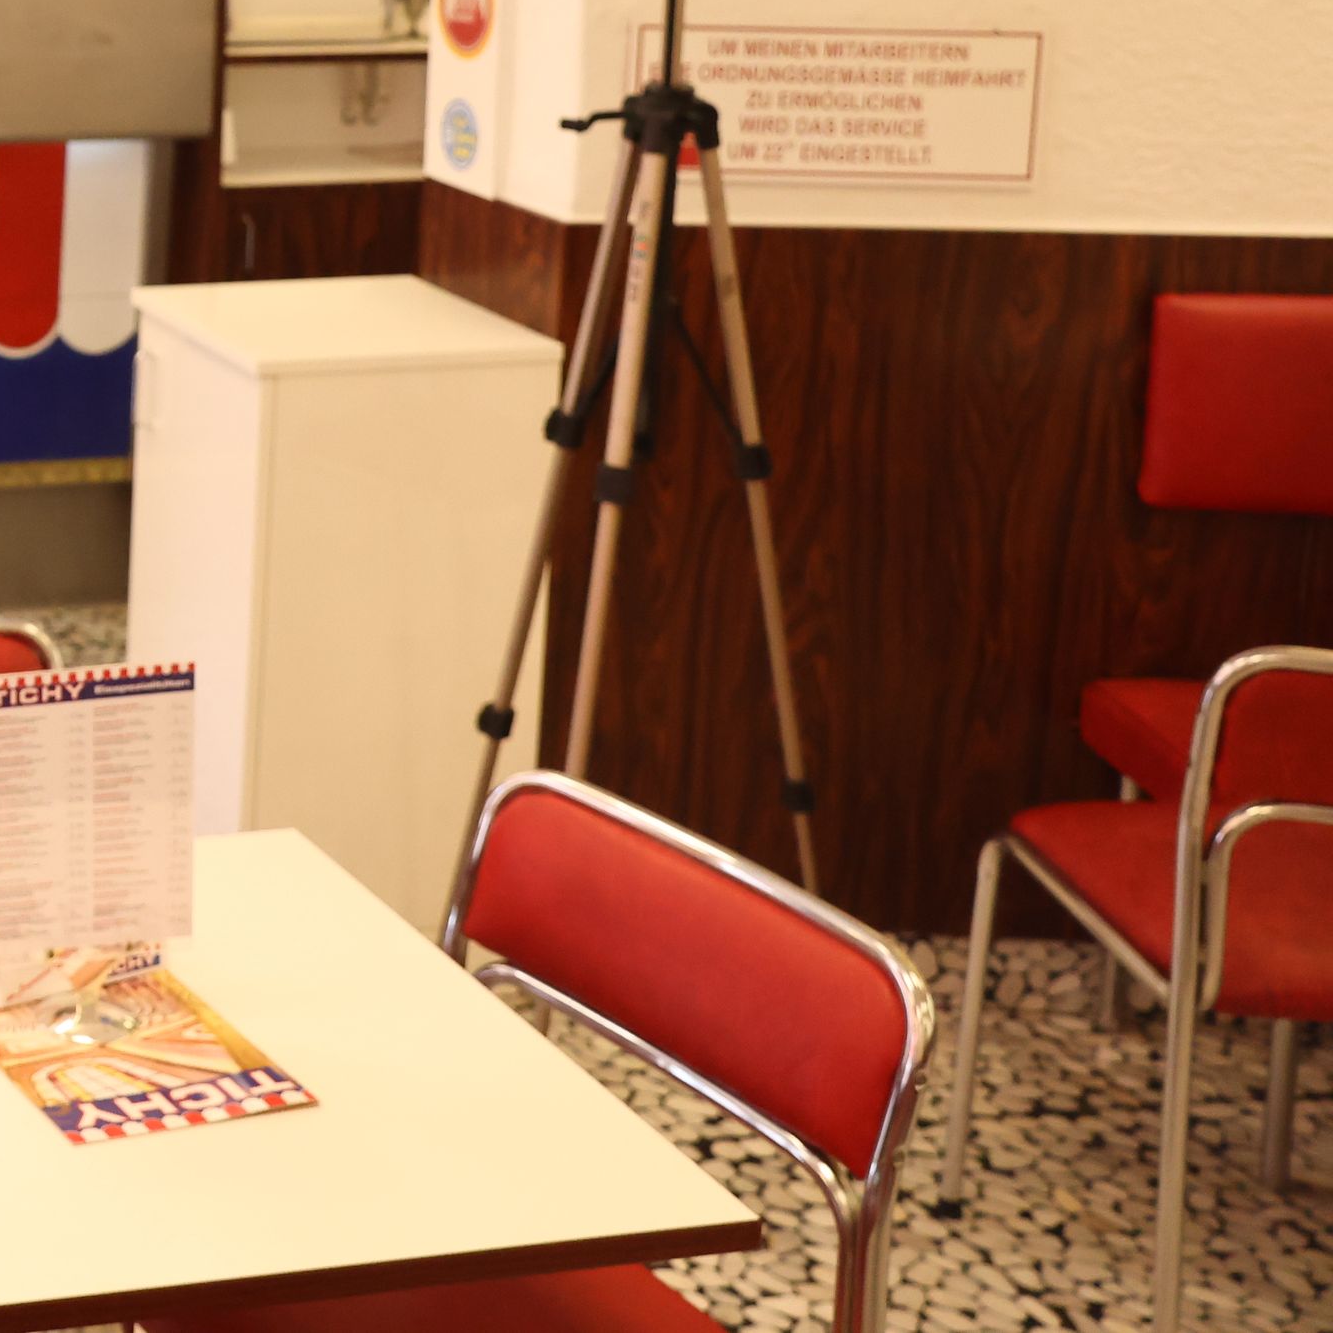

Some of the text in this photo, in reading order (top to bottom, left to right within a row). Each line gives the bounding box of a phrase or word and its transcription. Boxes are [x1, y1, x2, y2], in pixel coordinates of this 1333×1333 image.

[707, 39, 970, 61] UM MEINEN MITARBEITERN
[913, 69, 1027, 88] HEIMFAHRT
[745, 89, 924, 112] ZU ERMÖGLICHEN
[738, 116, 926, 138] WIRD DAS SERVICE
[799, 145, 933, 164] EINGESTELLT
[76, 1068, 296, 1130] TICHY
